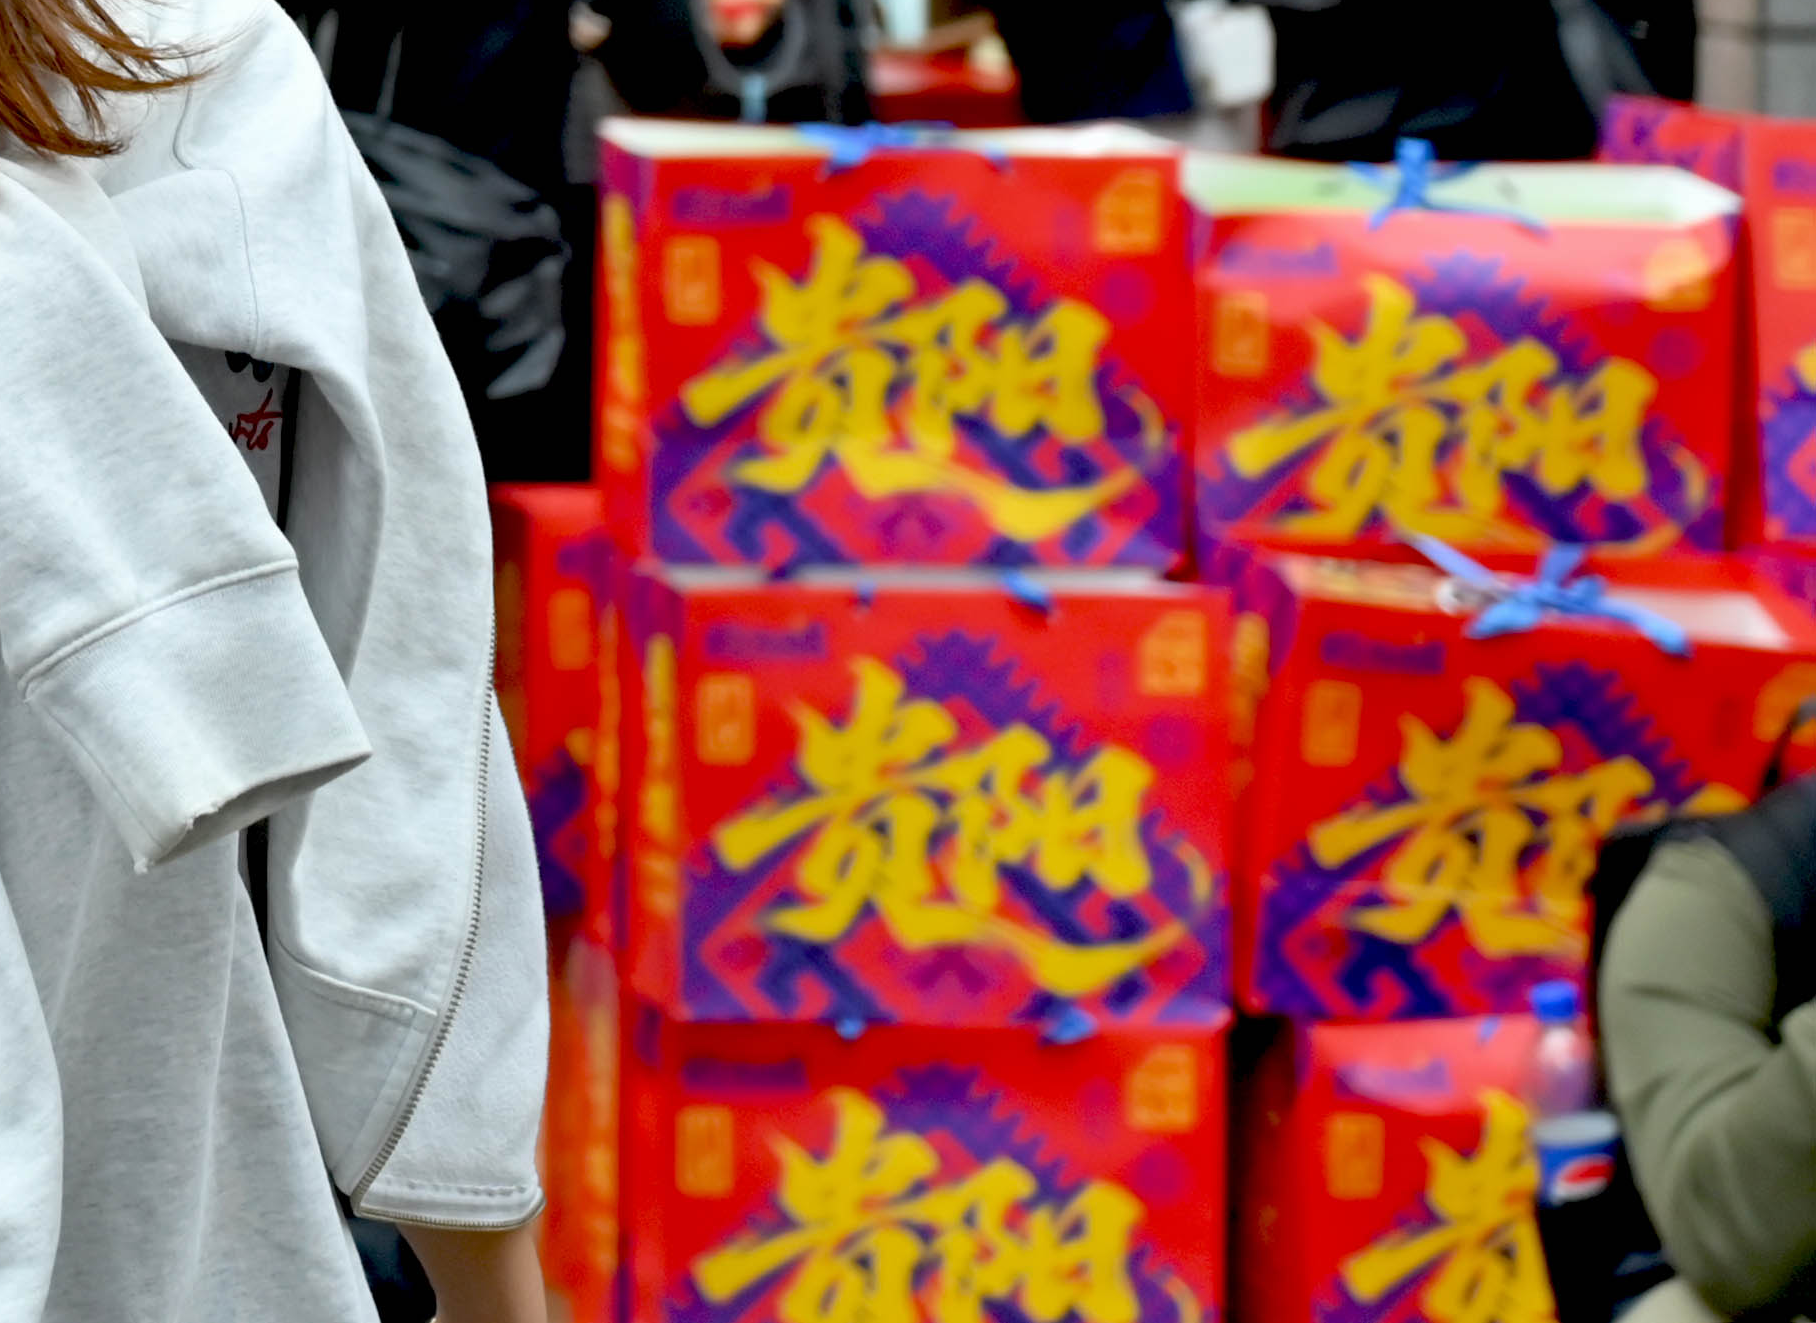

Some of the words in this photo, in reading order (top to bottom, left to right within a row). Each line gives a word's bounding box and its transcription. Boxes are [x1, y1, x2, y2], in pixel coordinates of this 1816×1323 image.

[681, 212, 1144, 542] 贵阳
[1227, 270, 1679, 549] 贵阳
[714, 656, 1189, 996] 贵阳
